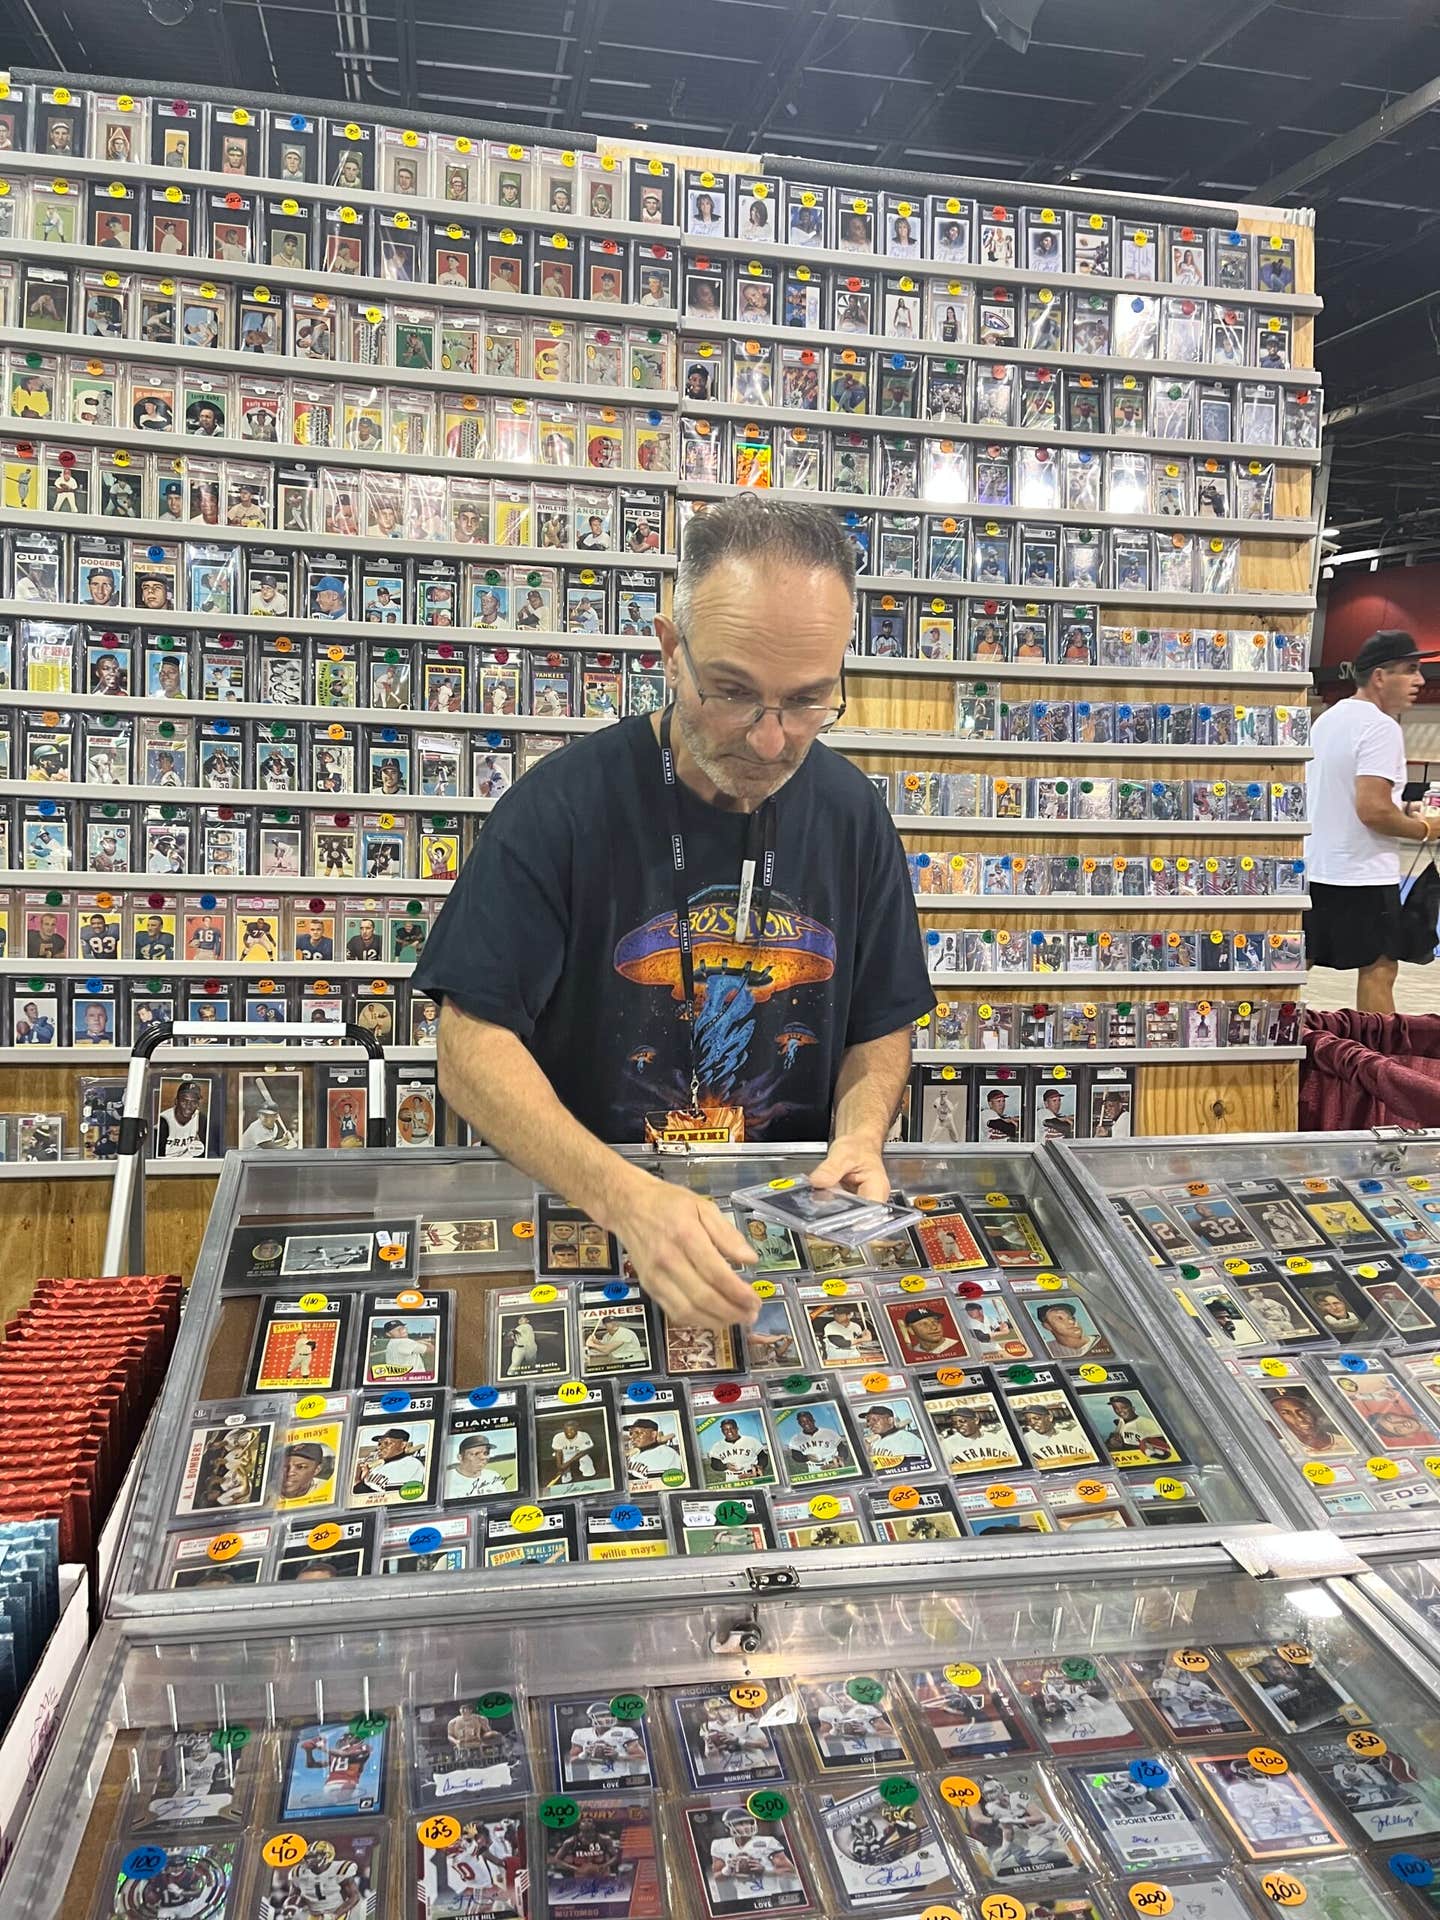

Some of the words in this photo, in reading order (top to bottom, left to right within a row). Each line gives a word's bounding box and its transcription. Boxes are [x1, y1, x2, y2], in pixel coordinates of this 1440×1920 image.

[81, 559, 121, 567] DODGERS
[664, 751, 673, 782] PANINI
[674, 836, 683, 868] PANINI
[199, 930, 213, 942] 16
[89, 937, 116, 953] 93
[363, 949, 379, 960] 12
[342, 1120, 353, 1130] 14
[667, 1131, 725, 1141] PANINI
[1200, 1217, 1239, 1238] 32
[327, 1302, 332, 1310] 6
[582, 1306, 643, 1317] YANKEES
[656, 1391, 667, 1400] 10
[410, 1401, 425, 1409] 8.5
[927, 1395, 991, 1409] GIANTS
[455, 1417, 509, 1428] GIANTS
[697, 1417, 716, 1431] GIANTS
[304, 1428, 328, 1439] mays
[799, 1440, 829, 1452] GIANTS
[188, 1442, 203, 1477] BOMBERS
[720, 1448, 751, 1460] GIANTS
[1113, 1455, 1139, 1463] MAYS
[879, 1457, 902, 1467] GIANTS
[885, 1467, 909, 1475] WILLIE
[401, 1487, 423, 1495] GIANTS
[1381, 1486, 1429, 1502] EDS
[549, 1517, 555, 1526] 5
[348, 1527, 356, 1536] 5
[493, 1550, 521, 1565] SPORT
[600, 1550, 626, 1559] willie
[631, 1545, 657, 1556] mays
[1178, 1656, 1205, 1666] 400
[736, 1690, 760, 1699] 650
[617, 1701, 643, 1712] 400
[355, 1718, 385, 1728] 100
[219, 1732, 246, 1743] 110
[1352, 1736, 1379, 1749] 250
[330, 1756, 349, 1772] 18
[1254, 1756, 1283, 1767] 400
[1137, 1766, 1163, 1776] 100
[602, 1781, 620, 1789] LOVE
[948, 1787, 974, 1797] 200
[545, 1805, 574, 1817] 200
[754, 1799, 783, 1812] 500
[1115, 1816, 1145, 1827] ROOKIE
[1148, 1813, 1176, 1822] TICKET
[426, 1825, 452, 1839] 125
[272, 1847, 298, 1862] 40
[132, 1855, 160, 1869] 100
[1014, 1866, 1032, 1874] MAXX
[1034, 1862, 1054, 1872] CROSBY
[1397, 1863, 1425, 1877] 100
[1266, 1883, 1301, 1903] 200
[1136, 1891, 1166, 1907] 200
[754, 1901, 772, 1909] LOVE
[555, 1909, 599, 1918] MUTOMBO
